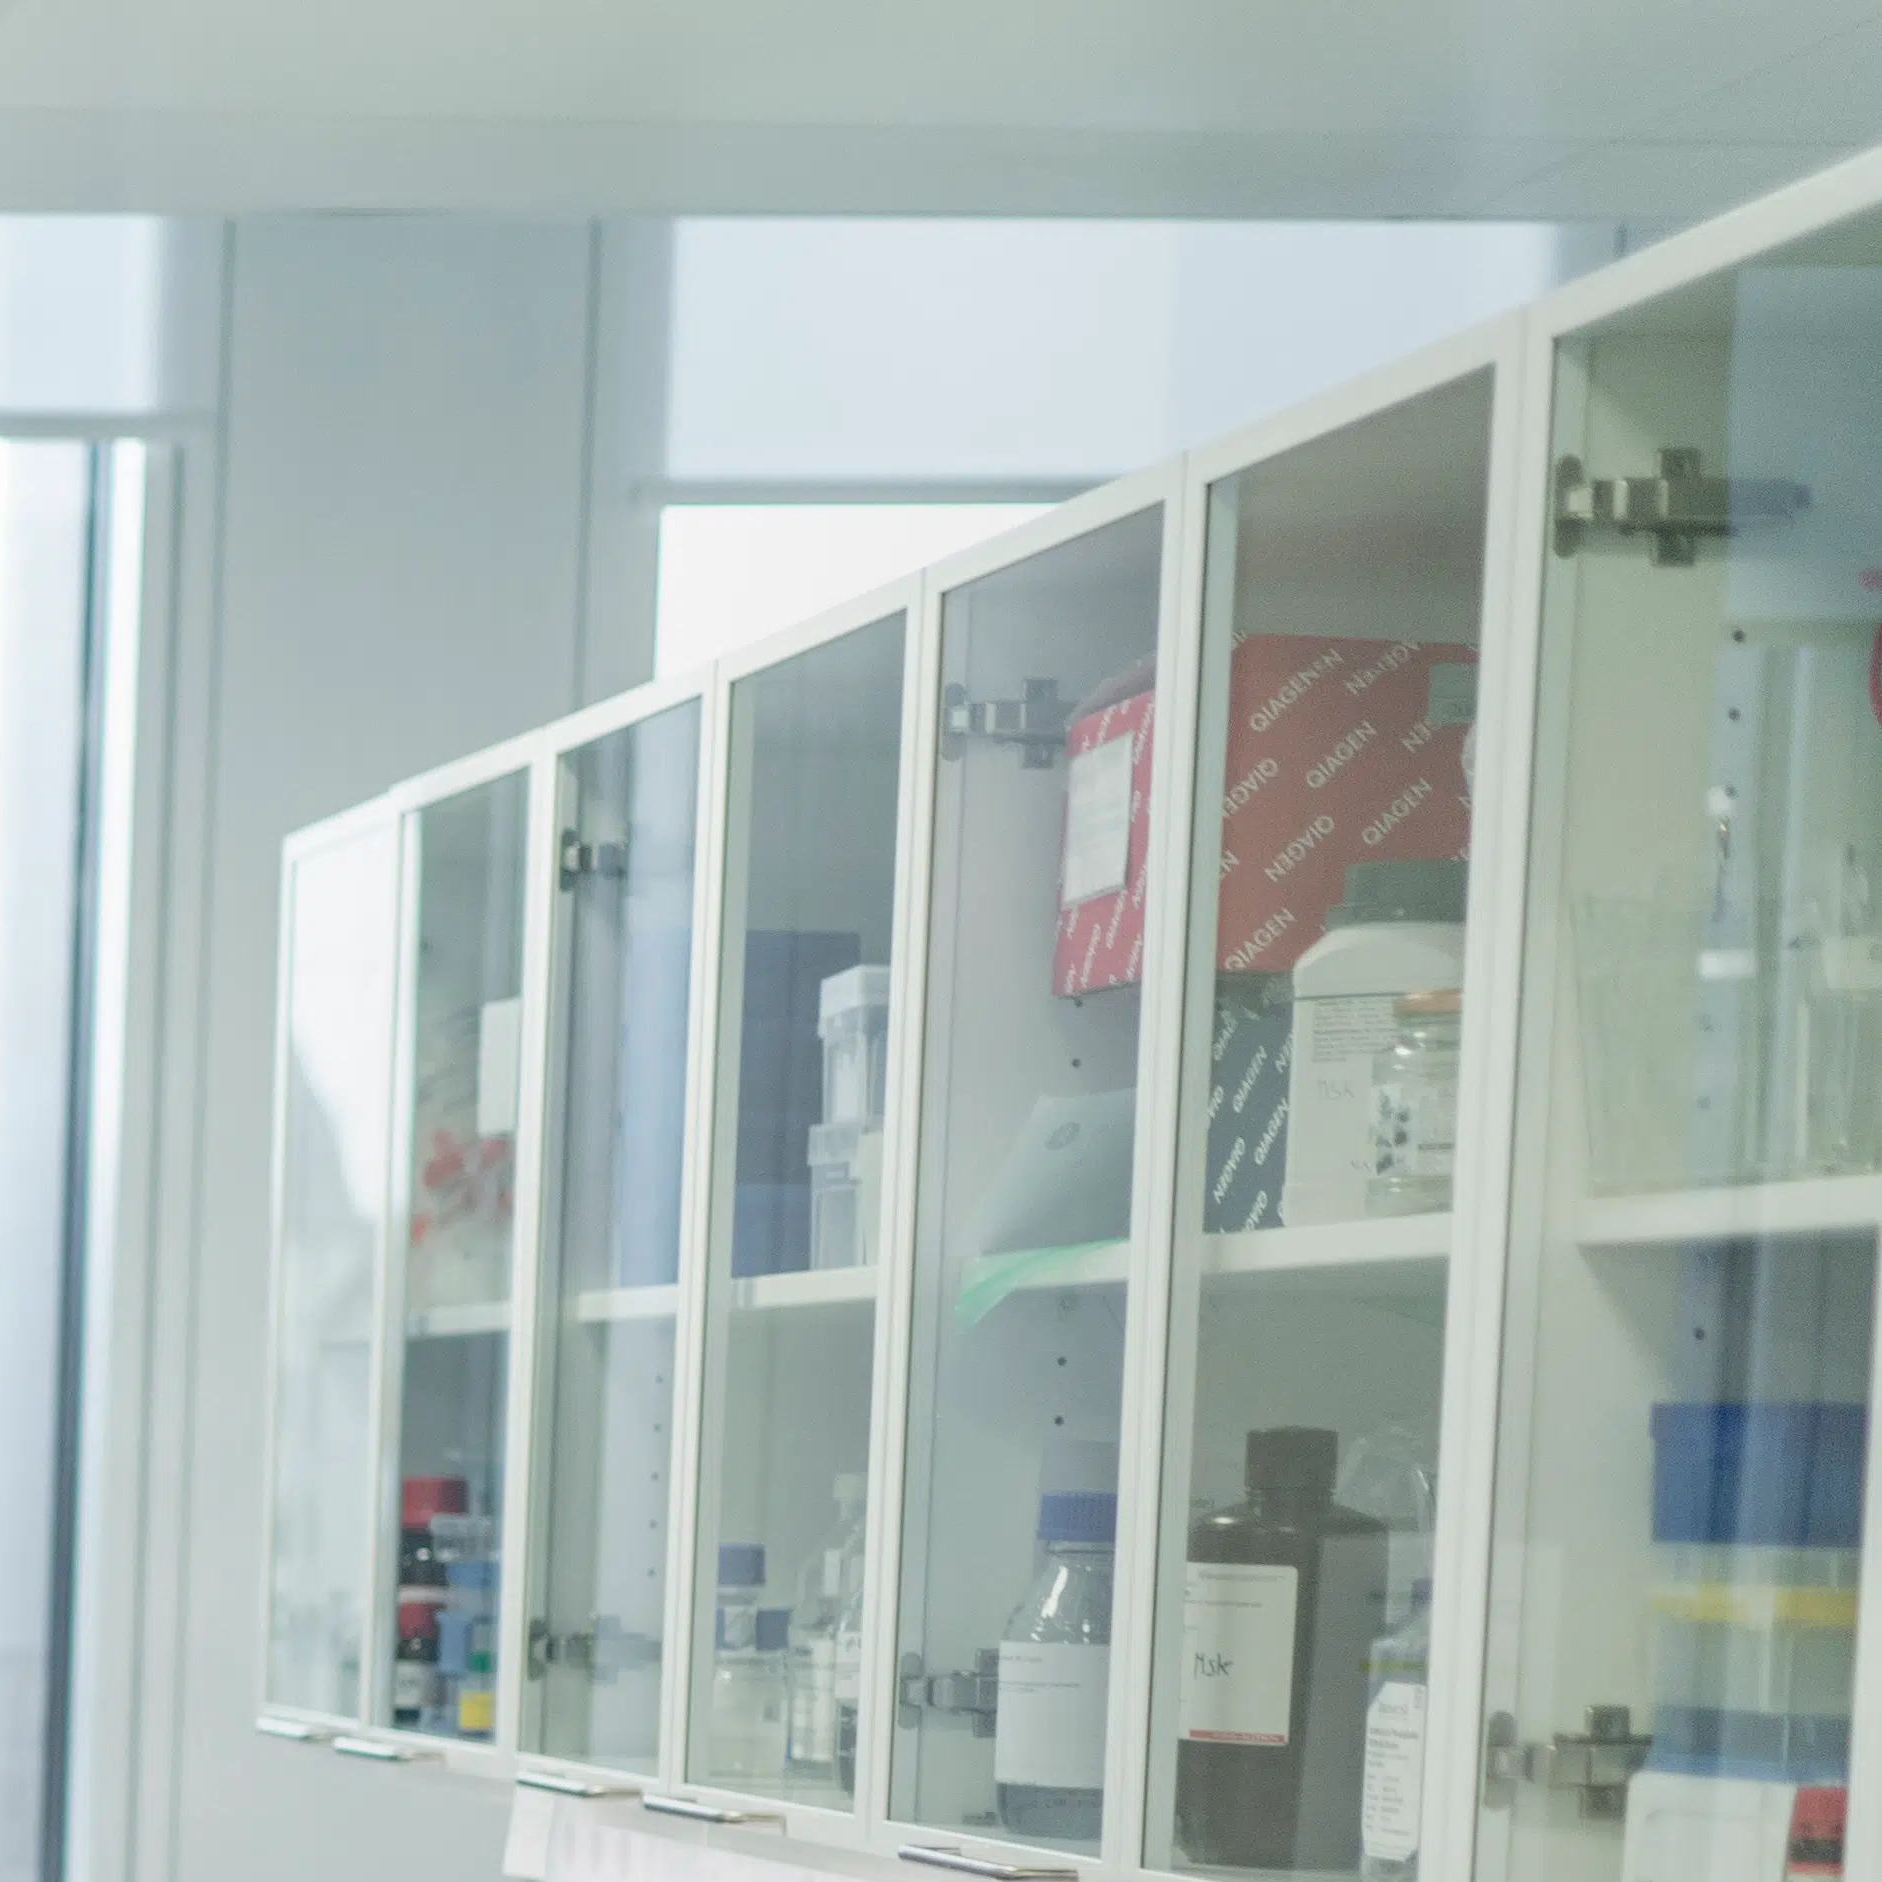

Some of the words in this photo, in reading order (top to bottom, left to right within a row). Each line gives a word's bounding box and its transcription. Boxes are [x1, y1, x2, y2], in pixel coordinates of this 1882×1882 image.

[1222, 757, 1279, 818] QIAGE
[1306, 719, 1378, 790] QIAGEN
[1361, 777, 1434, 846] QIAGEN
[1264, 815, 1335, 883] QIAGEN
[1224, 907, 1296, 970] QIAGEN
